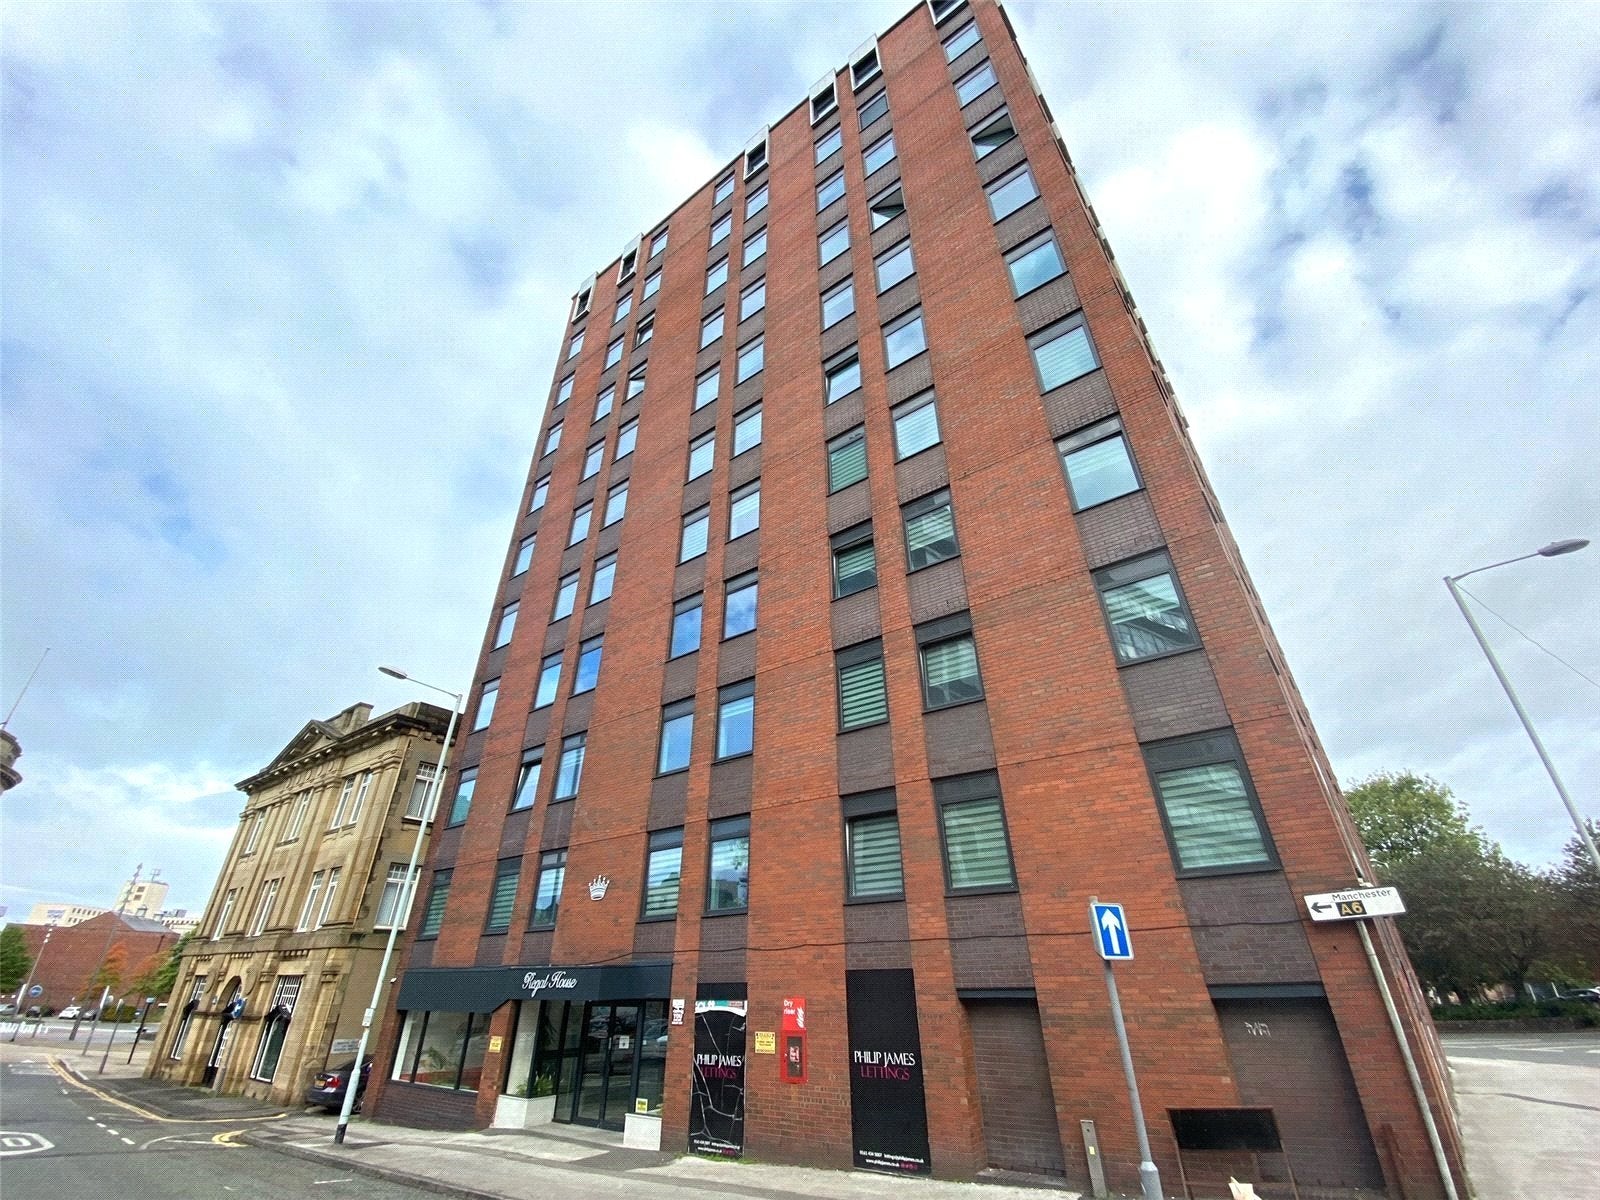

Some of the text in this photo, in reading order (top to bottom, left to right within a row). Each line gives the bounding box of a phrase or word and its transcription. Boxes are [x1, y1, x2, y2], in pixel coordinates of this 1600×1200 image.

[1332, 889, 1391, 902] Manchester
[1341, 902, 1363, 915] A6
[521, 970, 578, 998] Regal House
[696, 1053, 742, 1068] PHILIP JAMES
[854, 1050, 916, 1068] PHILIP JAMES
[860, 1065, 911, 1081] LETTINGS
